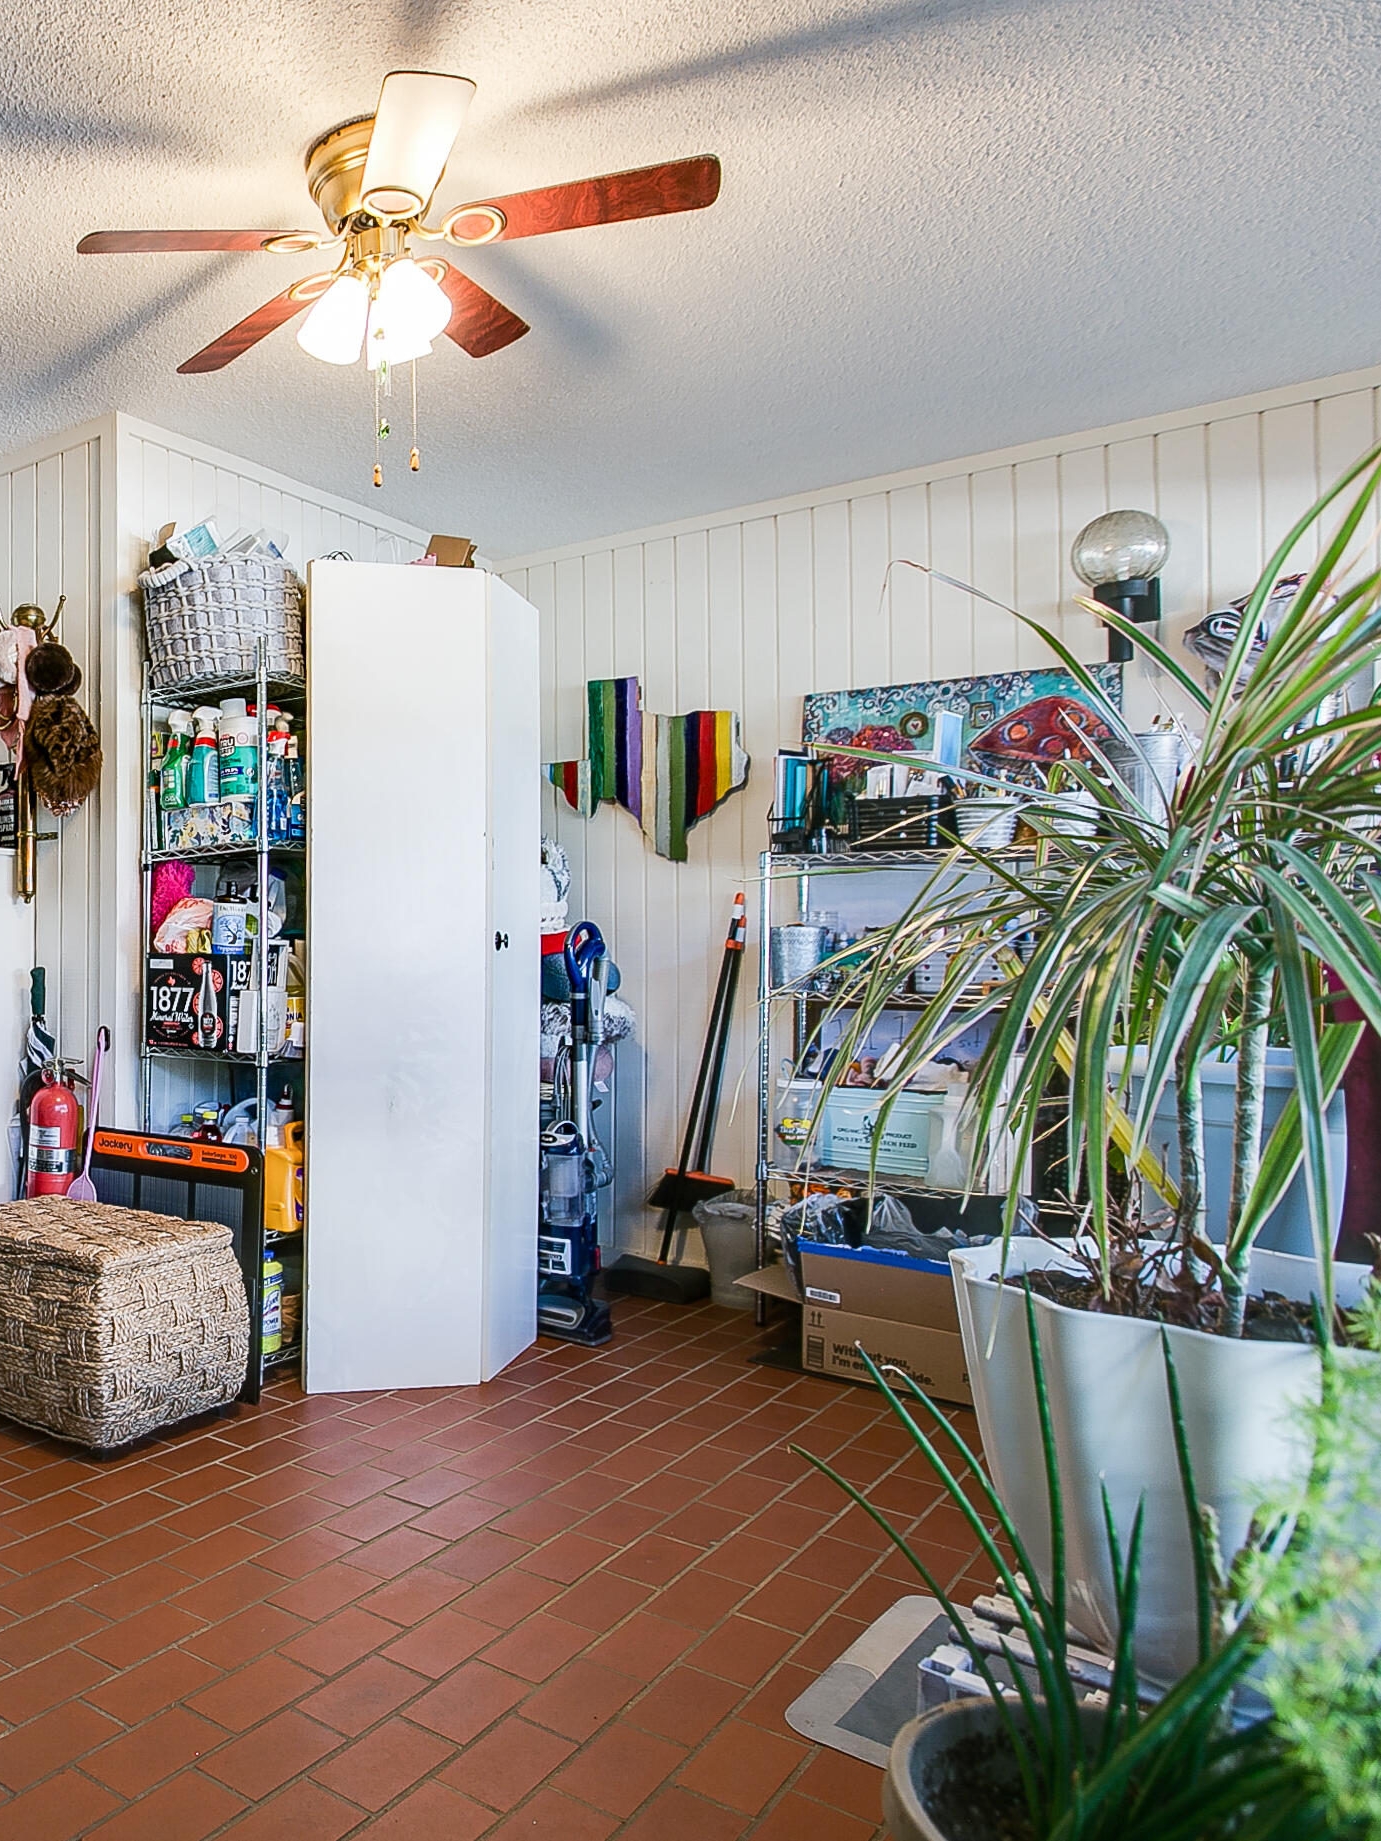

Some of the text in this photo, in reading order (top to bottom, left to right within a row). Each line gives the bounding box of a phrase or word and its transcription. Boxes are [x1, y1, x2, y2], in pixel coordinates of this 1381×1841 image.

[231, 960, 251, 982] 187
[150, 986, 195, 1012] 1877
[99, 1138, 132, 1151] Jackery
[832, 1342, 882, 1363] Withut
[832, 1354, 851, 1368] I'm
